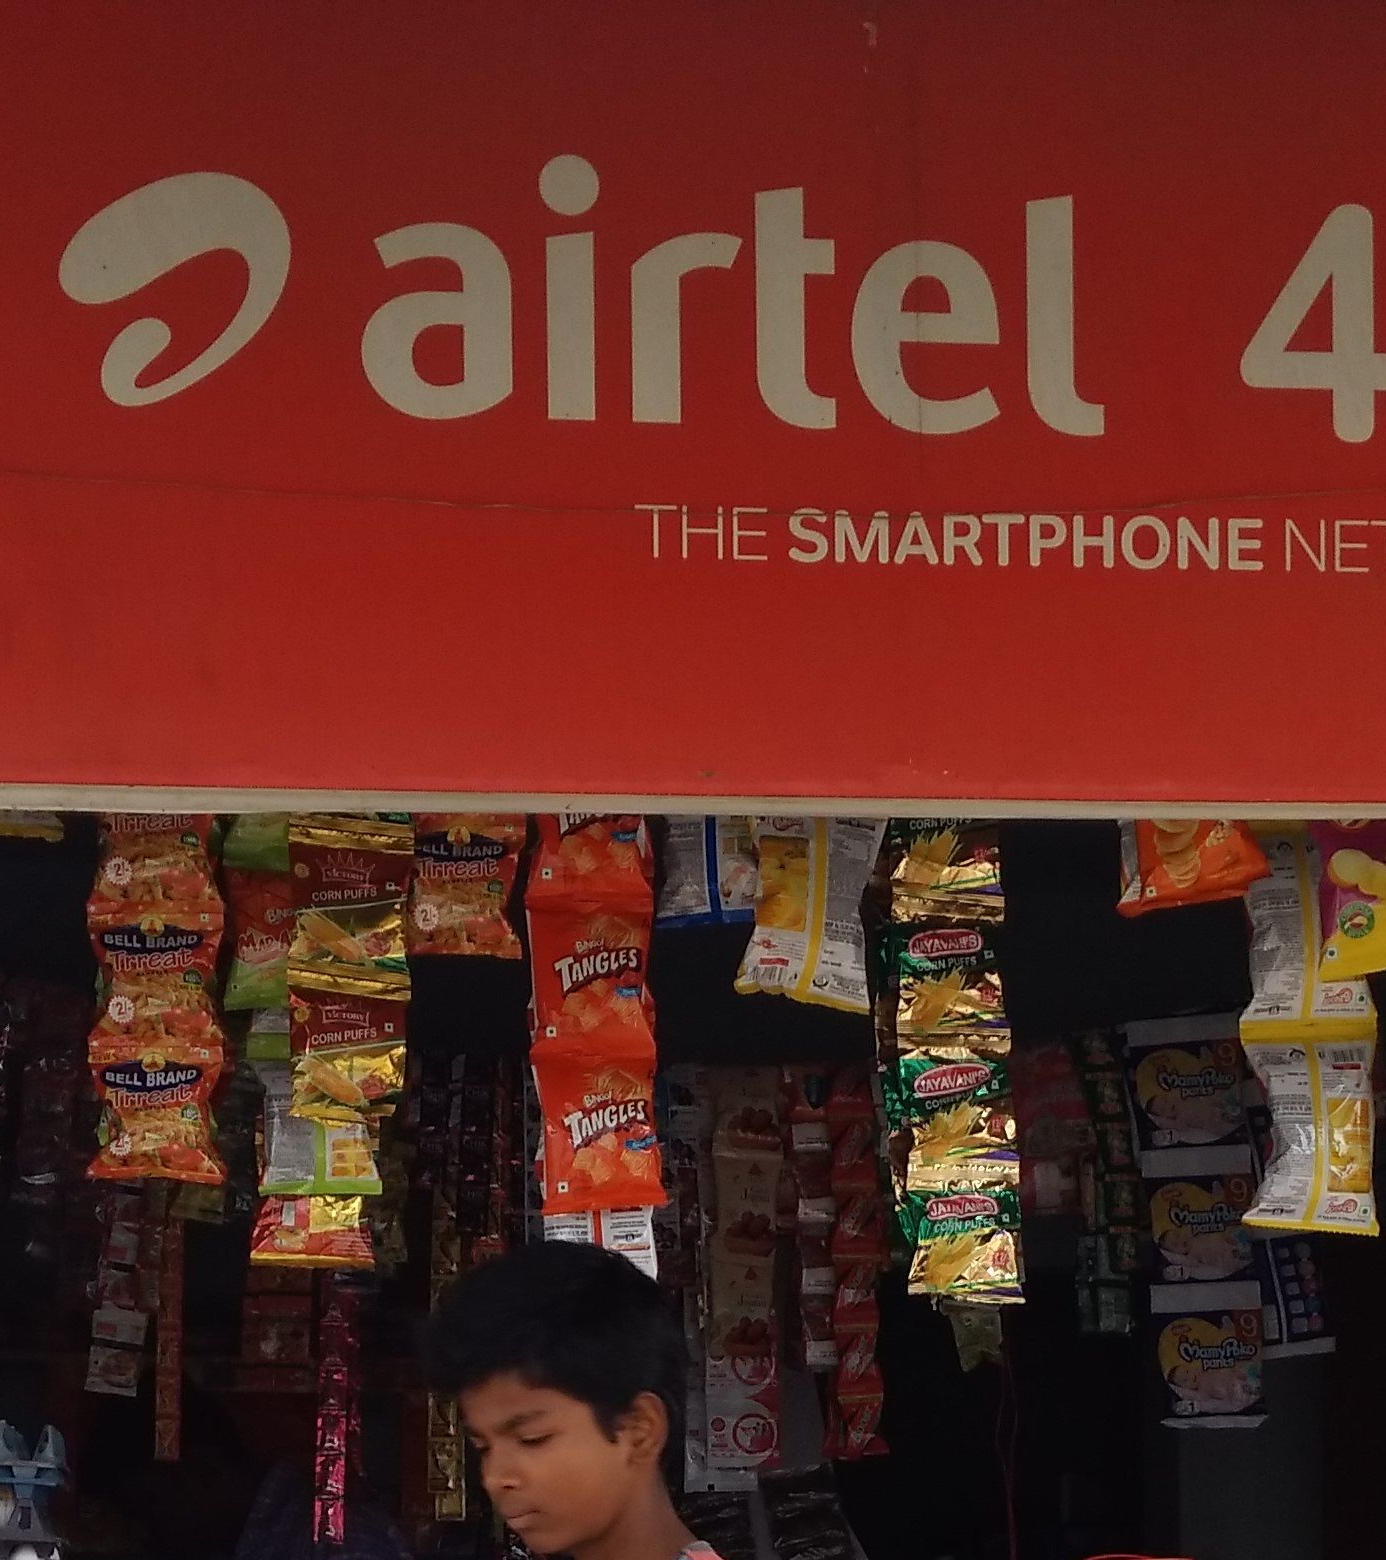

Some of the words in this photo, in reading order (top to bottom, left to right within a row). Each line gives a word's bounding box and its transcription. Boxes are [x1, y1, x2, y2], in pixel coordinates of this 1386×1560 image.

[361, 154, 1106, 438] airtel
[634, 504, 770, 563] THE
[788, 508, 1265, 573] SMARTPHONE
[418, 844, 450, 856] ELL
[418, 857, 500, 879] Trreat
[311, 889, 342, 902] CORN
[343, 885, 378, 900] PUFFS
[103, 934, 142, 949] BELL
[145, 935, 198, 949] BRAND
[112, 948, 193, 973] Trreat
[553, 948, 639, 991] TANGLES
[948, 956, 978, 969] PUFFS
[310, 1031, 342, 1045] CORN
[343, 1027, 378, 1042] PUFFS
[104, 1070, 143, 1086] BELL
[145, 1069, 198, 1087] BRAND
[915, 1068, 988, 1093] JAYAVANI'S
[1157, 1066, 1235, 1091] MamyPoko
[112, 1083, 193, 1109] Trreat
[562, 1100, 646, 1148] TANGLES
[1178, 1337, 1258, 1362] MamyPoko
